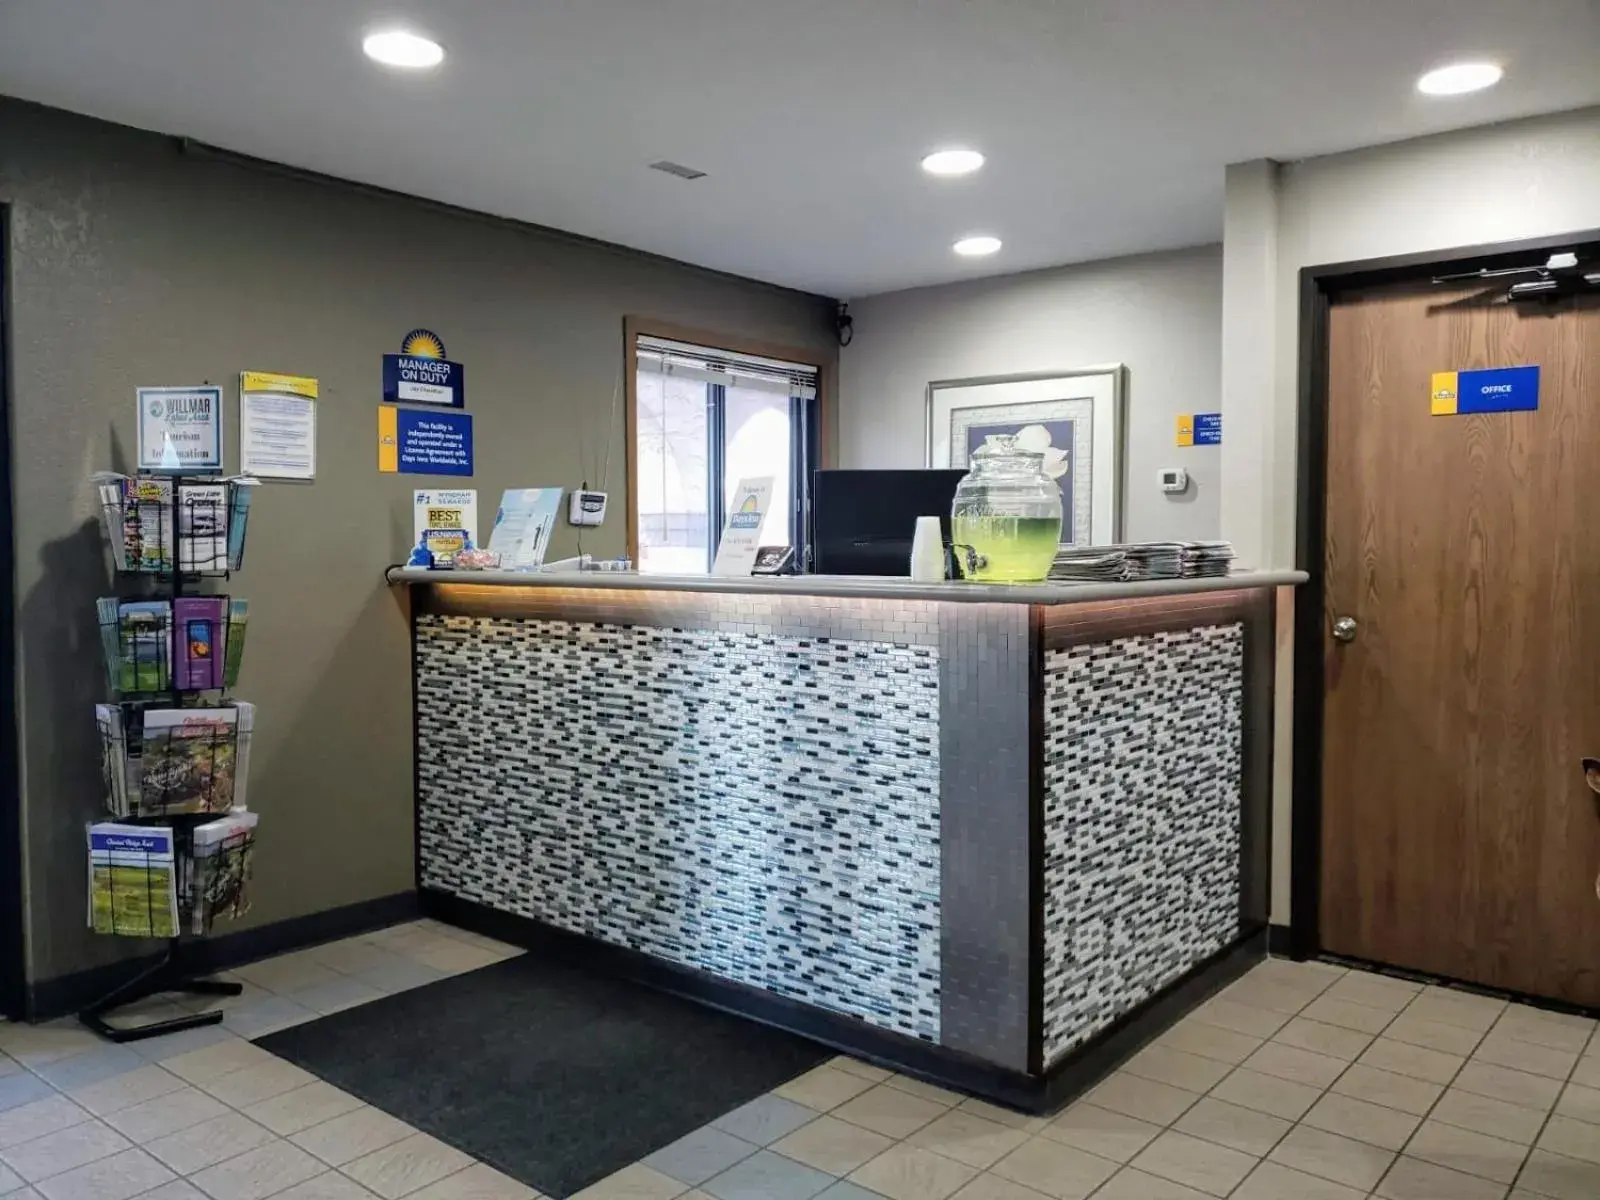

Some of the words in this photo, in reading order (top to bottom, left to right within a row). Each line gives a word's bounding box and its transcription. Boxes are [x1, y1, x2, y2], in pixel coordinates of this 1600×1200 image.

[398, 358, 450, 374] MANAGER
[401, 370, 418, 381] ON
[420, 371, 448, 384] DUTY
[1481, 384, 1512, 395] OFFICE
[165, 398, 211, 414] WILLMAR
[418, 421, 430, 429] This
[431, 423, 447, 432] facility
[407, 429, 444, 440] independently
[419, 440, 441, 448] operated
[416, 493, 431, 505] #1
[428, 510, 462, 521] BEST
